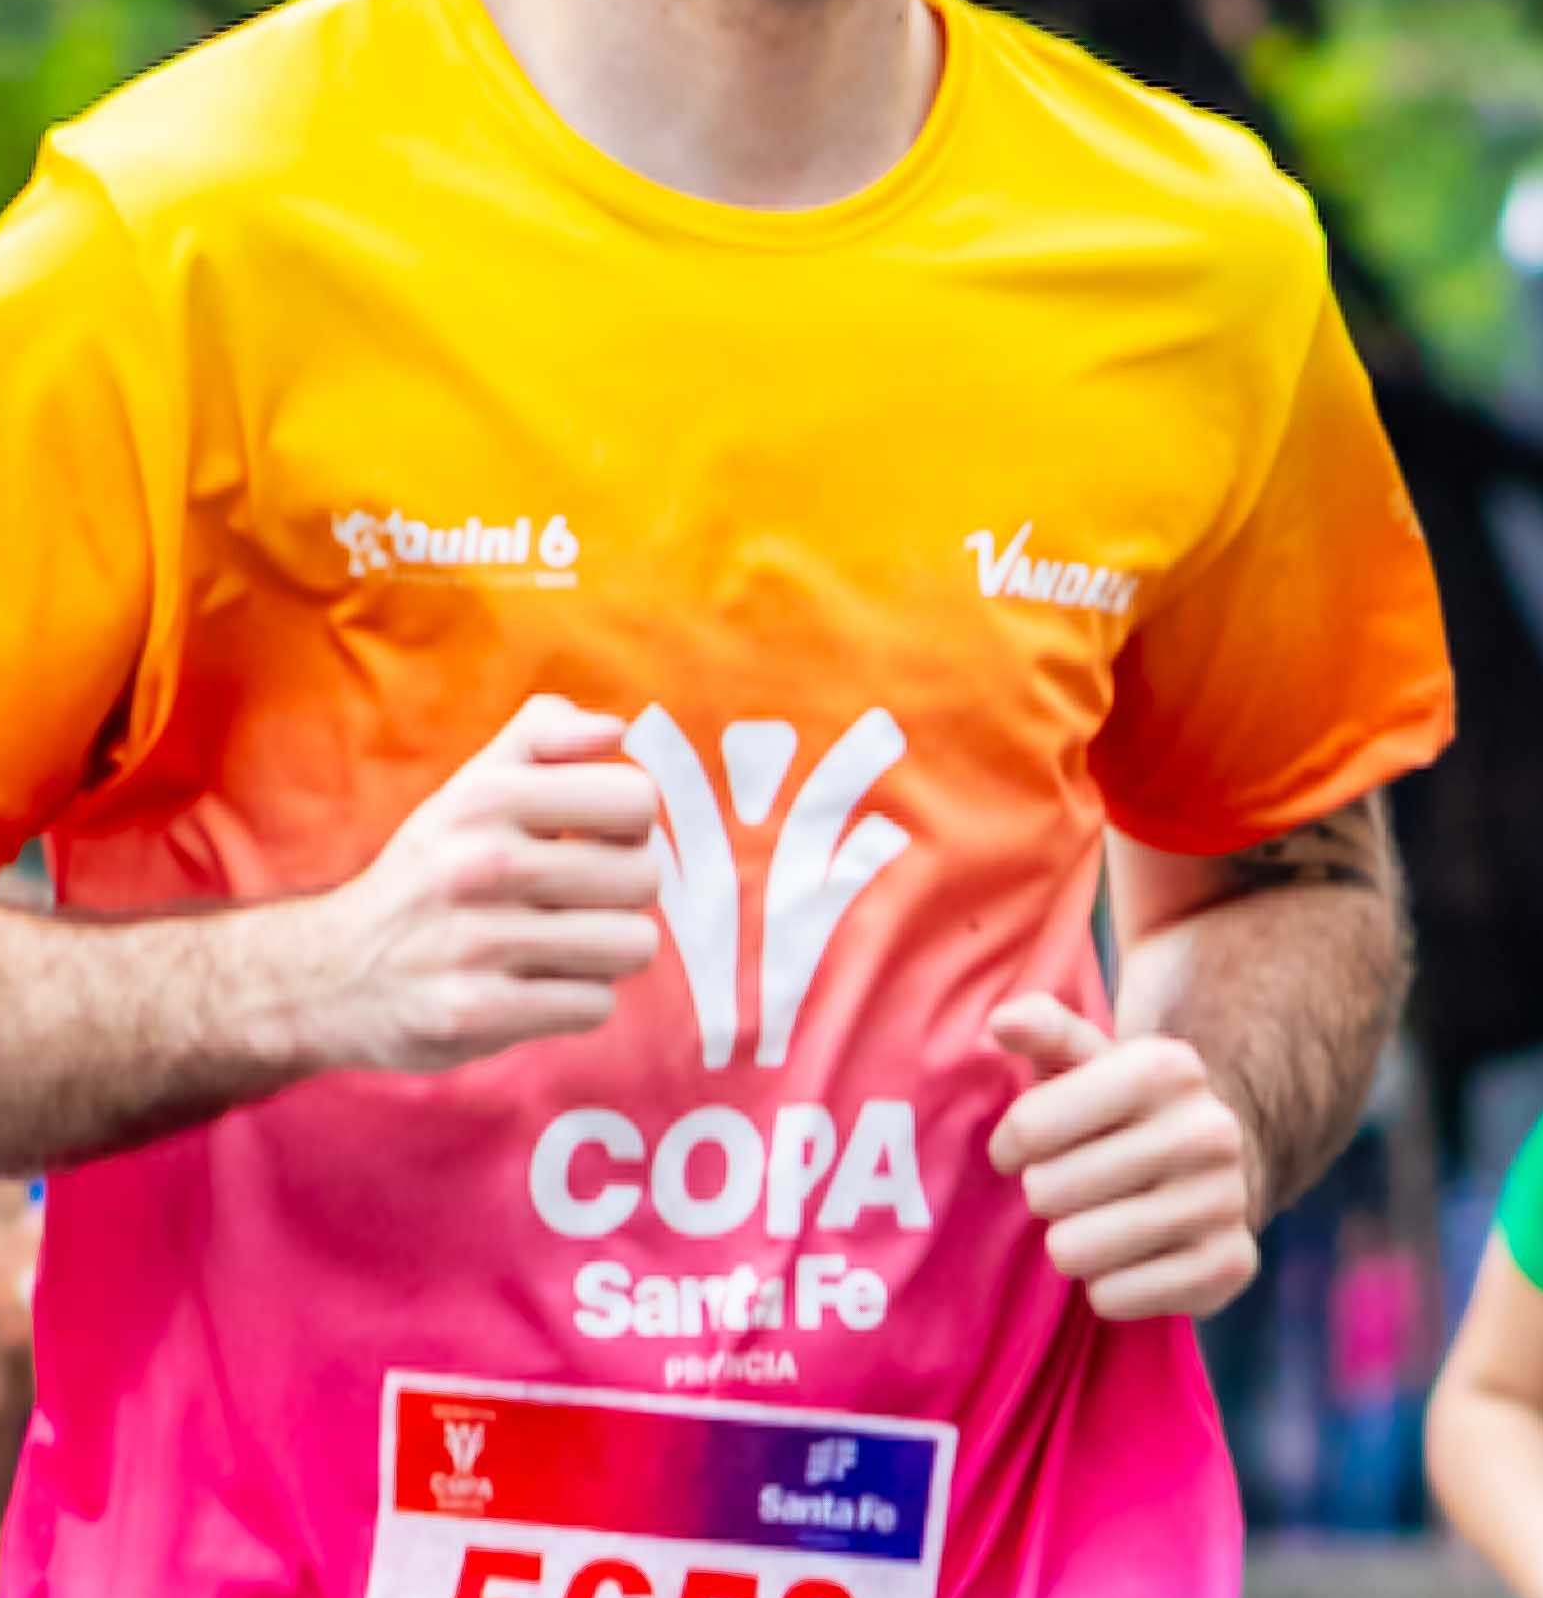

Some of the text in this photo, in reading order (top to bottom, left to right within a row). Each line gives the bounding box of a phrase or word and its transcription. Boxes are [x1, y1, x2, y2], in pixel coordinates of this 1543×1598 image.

[539, 513, 579, 570] 6
[530, 1100, 931, 1239] COPA
[573, 1253, 887, 1339] Santa Fe
